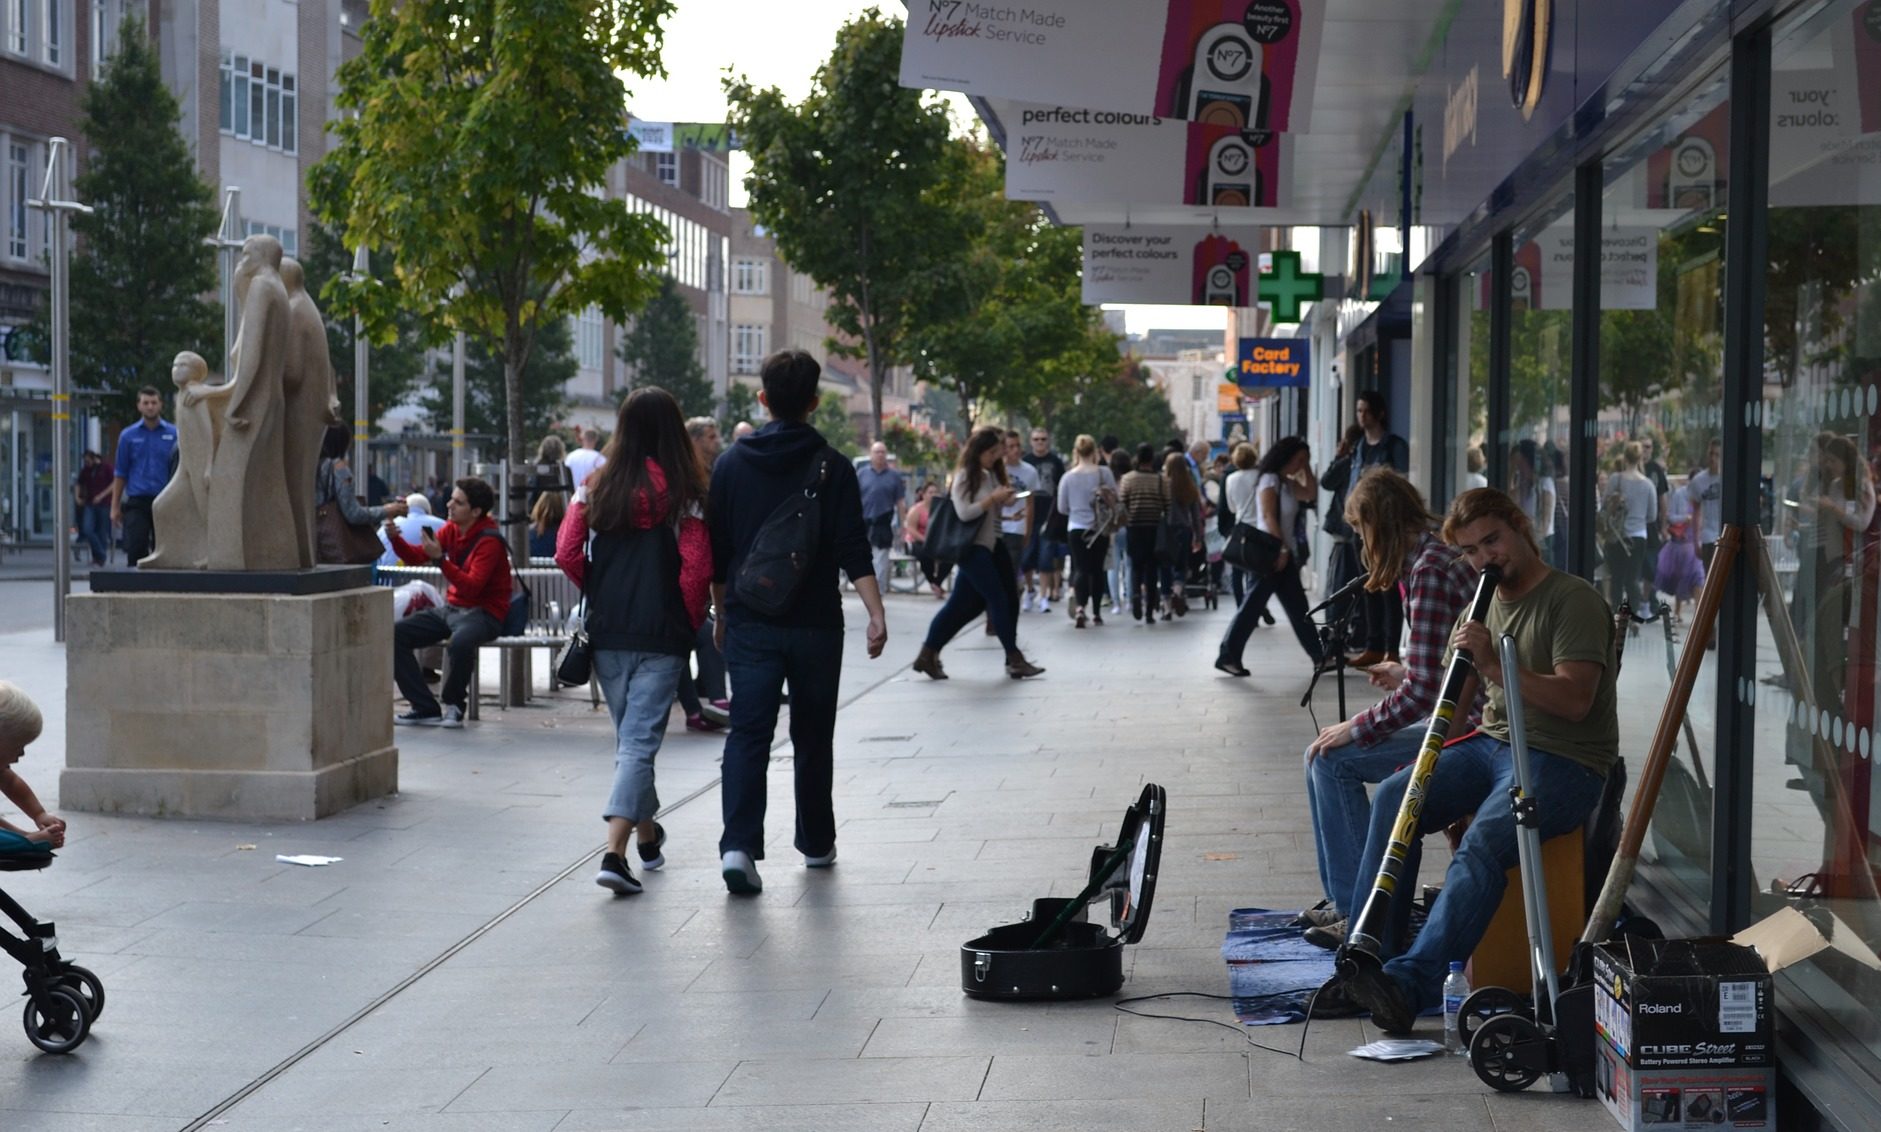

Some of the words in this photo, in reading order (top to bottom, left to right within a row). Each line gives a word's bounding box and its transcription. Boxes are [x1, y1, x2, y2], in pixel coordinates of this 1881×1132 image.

[965, 3, 1016, 22] Match
[1020, 9, 1065, 28] Made
[1254, 4, 1285, 13] Another
[985, 25, 1046, 45] Service
[1022, 106, 1090, 126] perfect
[1094, 111, 1162, 126] colours
[1047, 137, 1083, 148] Match
[1085, 138, 1118, 150] Made
[1062, 151, 1105, 162] Service
[1092, 233, 1143, 244] Discover
[1146, 235, 1171, 247] your
[1092, 248, 1134, 260] perfect
[1136, 249, 1178, 260] colours
[1253, 346, 1290, 361] Card
[1242, 359, 1300, 377] Factory
[1639, 1002, 1682, 1014] Roland
[1640, 1044, 1692, 1055] CUBE
[1692, 1041, 1736, 1056] Street
[1640, 1058, 1661, 1066] Battery
[1689, 1057, 1708, 1065] Stereo
[1709, 1056, 1735, 1065] Amplifier
